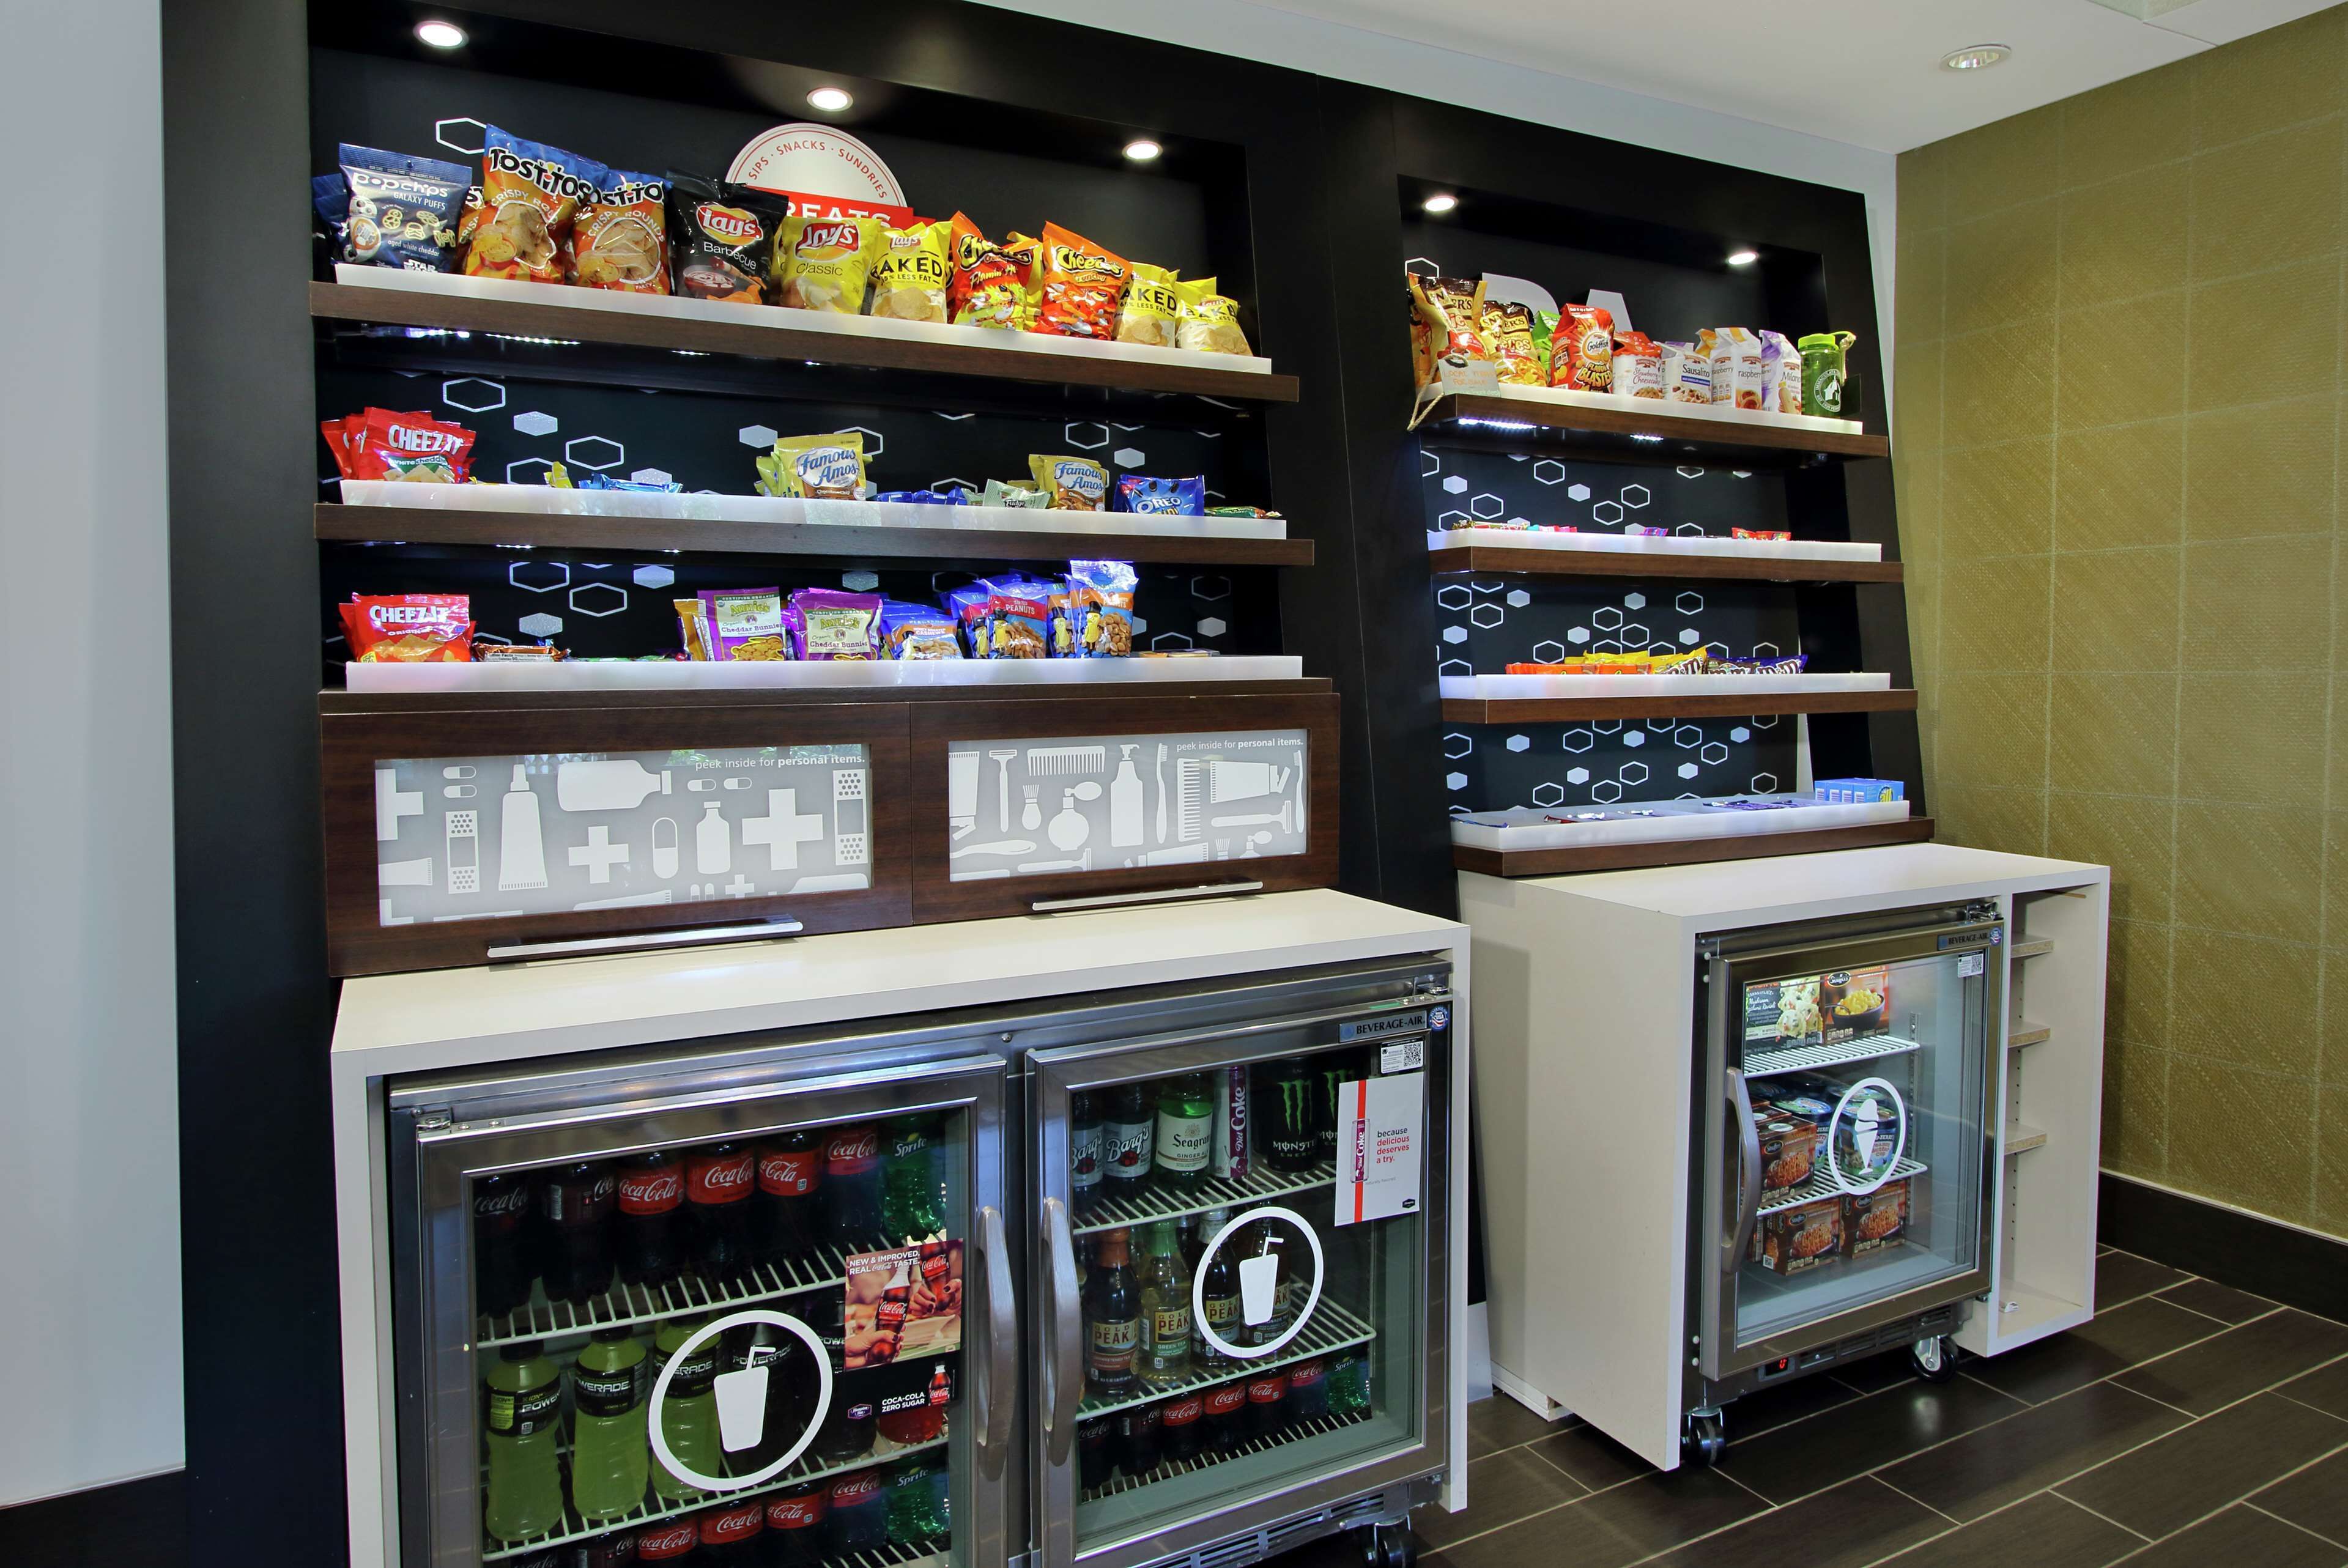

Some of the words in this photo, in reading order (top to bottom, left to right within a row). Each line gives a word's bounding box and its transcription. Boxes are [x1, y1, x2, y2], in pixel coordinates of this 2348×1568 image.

[749, 156, 768, 180] SIPS
[776, 140, 826, 155] SNACKS
[838, 148, 887, 199] SUNDRIES
[393, 192, 422, 205] GALAXY
[424, 199, 446, 210] PUFFS
[491, 188, 528, 207] CRISPY
[588, 210, 618, 237] CRISPY
[625, 210, 665, 242] ROUNDS
[703, 209, 757, 238] Lay's
[388, 239, 402, 249] aged
[402, 242, 417, 252] white
[418, 244, 440, 257] cheddar
[703, 242, 757, 270] Barbecue
[796, 262, 843, 276] Classic
[1120, 286, 1177, 311] AKED
[1155, 306, 1166, 314] FAT
[1587, 339, 1609, 352] Goldfish
[1683, 364, 1710, 378] Sausalito
[797, 449, 856, 477] Famous
[1054, 461, 1102, 479] Famous
[813, 464, 859, 486] Amos
[1067, 476, 1103, 490] Amos
[1136, 497, 1182, 514] OREO
[730, 600, 771, 617] Annie's
[1005, 604, 1035, 615] PEANUTS
[1177, 742, 1196, 753] peek
[1199, 741, 1222, 750] inside
[1224, 739, 1236, 749] for
[1238, 738, 1275, 750] personal
[1277, 737, 1304, 746] items.
[695, 758, 722, 771] peek
[725, 757, 756, 768] inside
[760, 756, 775, 767] for
[777, 755, 828, 768] personal
[831, 754, 865, 765] items.
[1947, 933, 1988, 945] BEVERAGE-AIR
[1357, 1016, 1426, 1035] BEVERAGE-AIR
[1231, 1086, 1246, 1131] Coke
[1377, 1127, 1408, 1138] because
[1377, 1136, 1410, 1147] delicious
[828, 1134, 877, 1161] Coca-Col
[894, 1136, 927, 1160] Sprite
[1106, 1126, 1150, 1162] Barq's
[1377, 1144, 1410, 1155] deserves
[705, 1157, 755, 1188] Coca-Col
[620, 1174, 678, 1202] Coca-Cola
[850, 1257, 869, 1268] NEW
[878, 1250, 920, 1262] IMPROVED.
[850, 1265, 872, 1276] REAL
[894, 1257, 920, 1268] TASTE.
[922, 1254, 946, 1272] Coca-Cola
[879, 1301, 907, 1314] Coca-Cola
[1158, 1315, 1189, 1331] PEAK
[1095, 1331, 1130, 1344] PEAK
[1335, 1357, 1356, 1372] Sprite
[881, 1392, 925, 1407] COCA-COLA
[930, 1387, 949, 1399] Coca-Cola
[881, 1403, 901, 1413] ZERO
[902, 1398, 925, 1410] SUGAR
[1163, 1402, 1199, 1420] Coca-Cola
[897, 1468, 929, 1487] Sprite
[717, 1505, 762, 1533] Coca-Col
[640, 1528, 692, 1550] Coca-Cola
